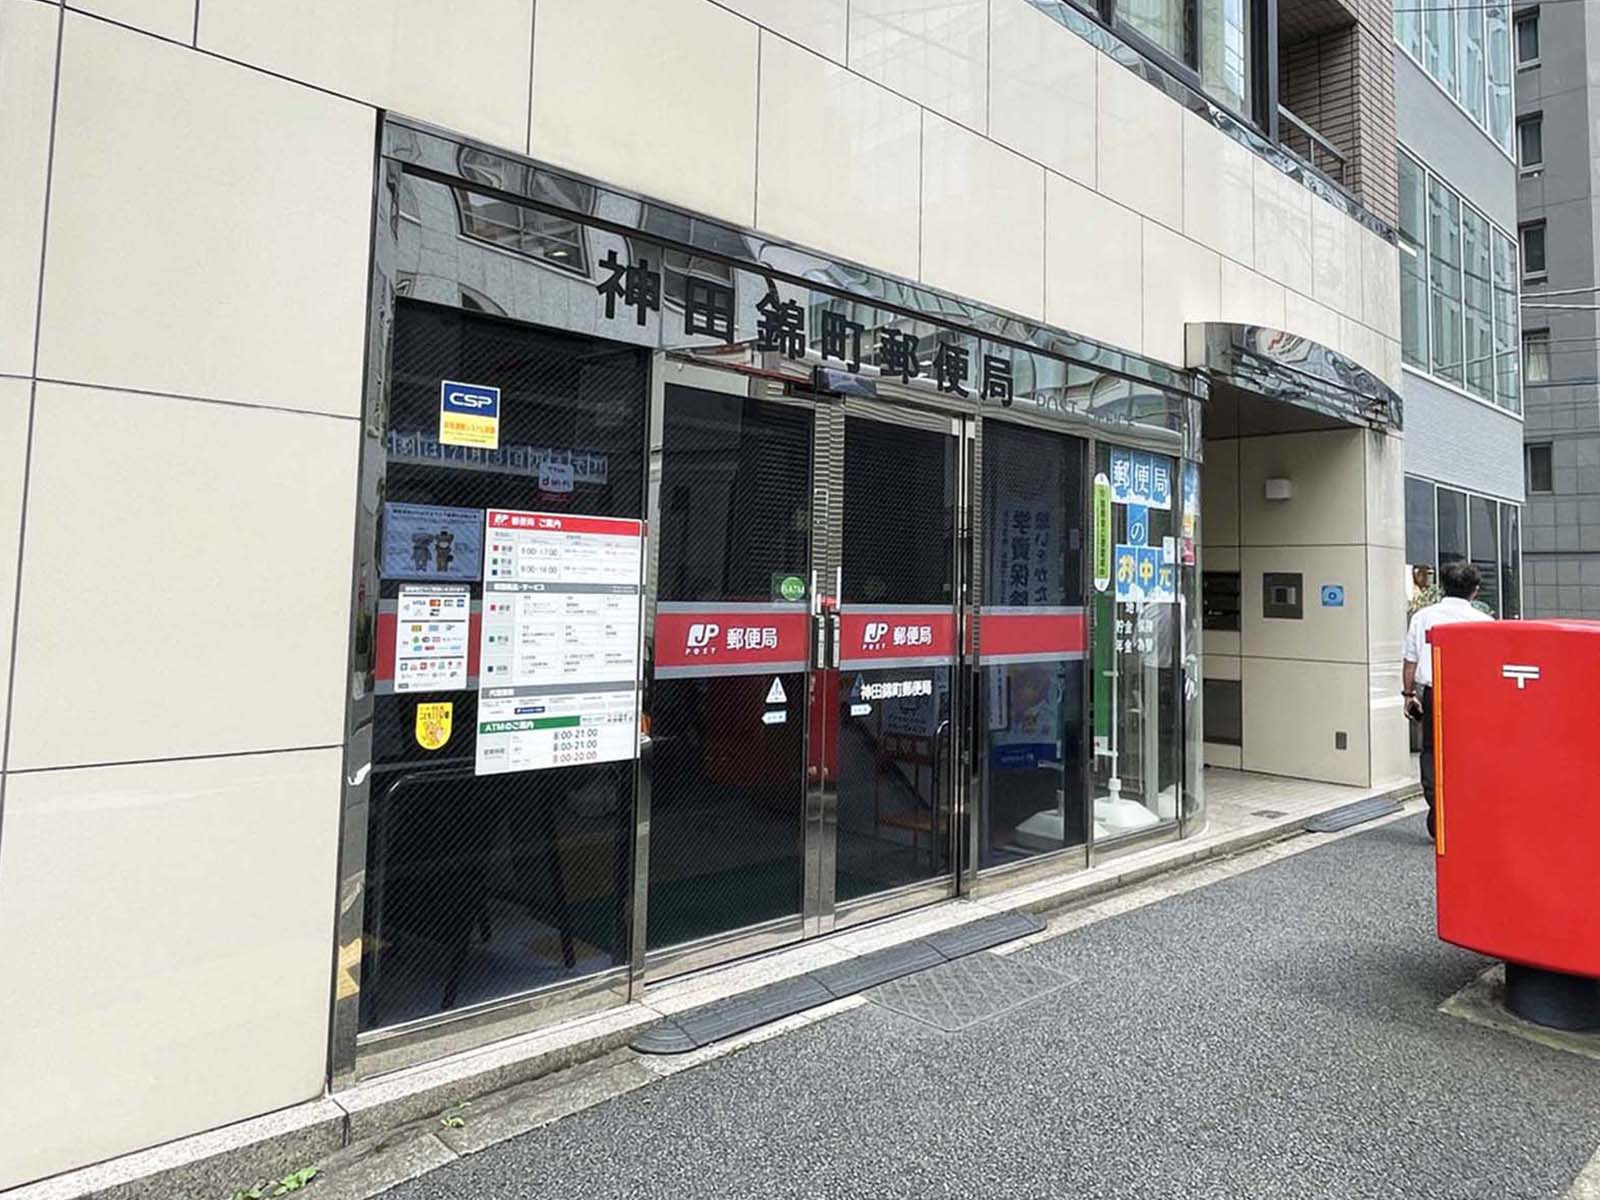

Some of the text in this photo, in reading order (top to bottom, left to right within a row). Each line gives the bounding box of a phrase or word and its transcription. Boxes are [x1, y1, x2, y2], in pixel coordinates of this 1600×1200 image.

[597, 250, 1014, 406] 神田錦町郵便局
[449, 392, 492, 409] CSP
[1113, 459, 1169, 497] 郵便局
[1131, 522, 1144, 543] の
[726, 627, 778, 650] 郵便局
[893, 626, 932, 646] 郵便局
[860, 680, 933, 701] 神田錦町郵便局
